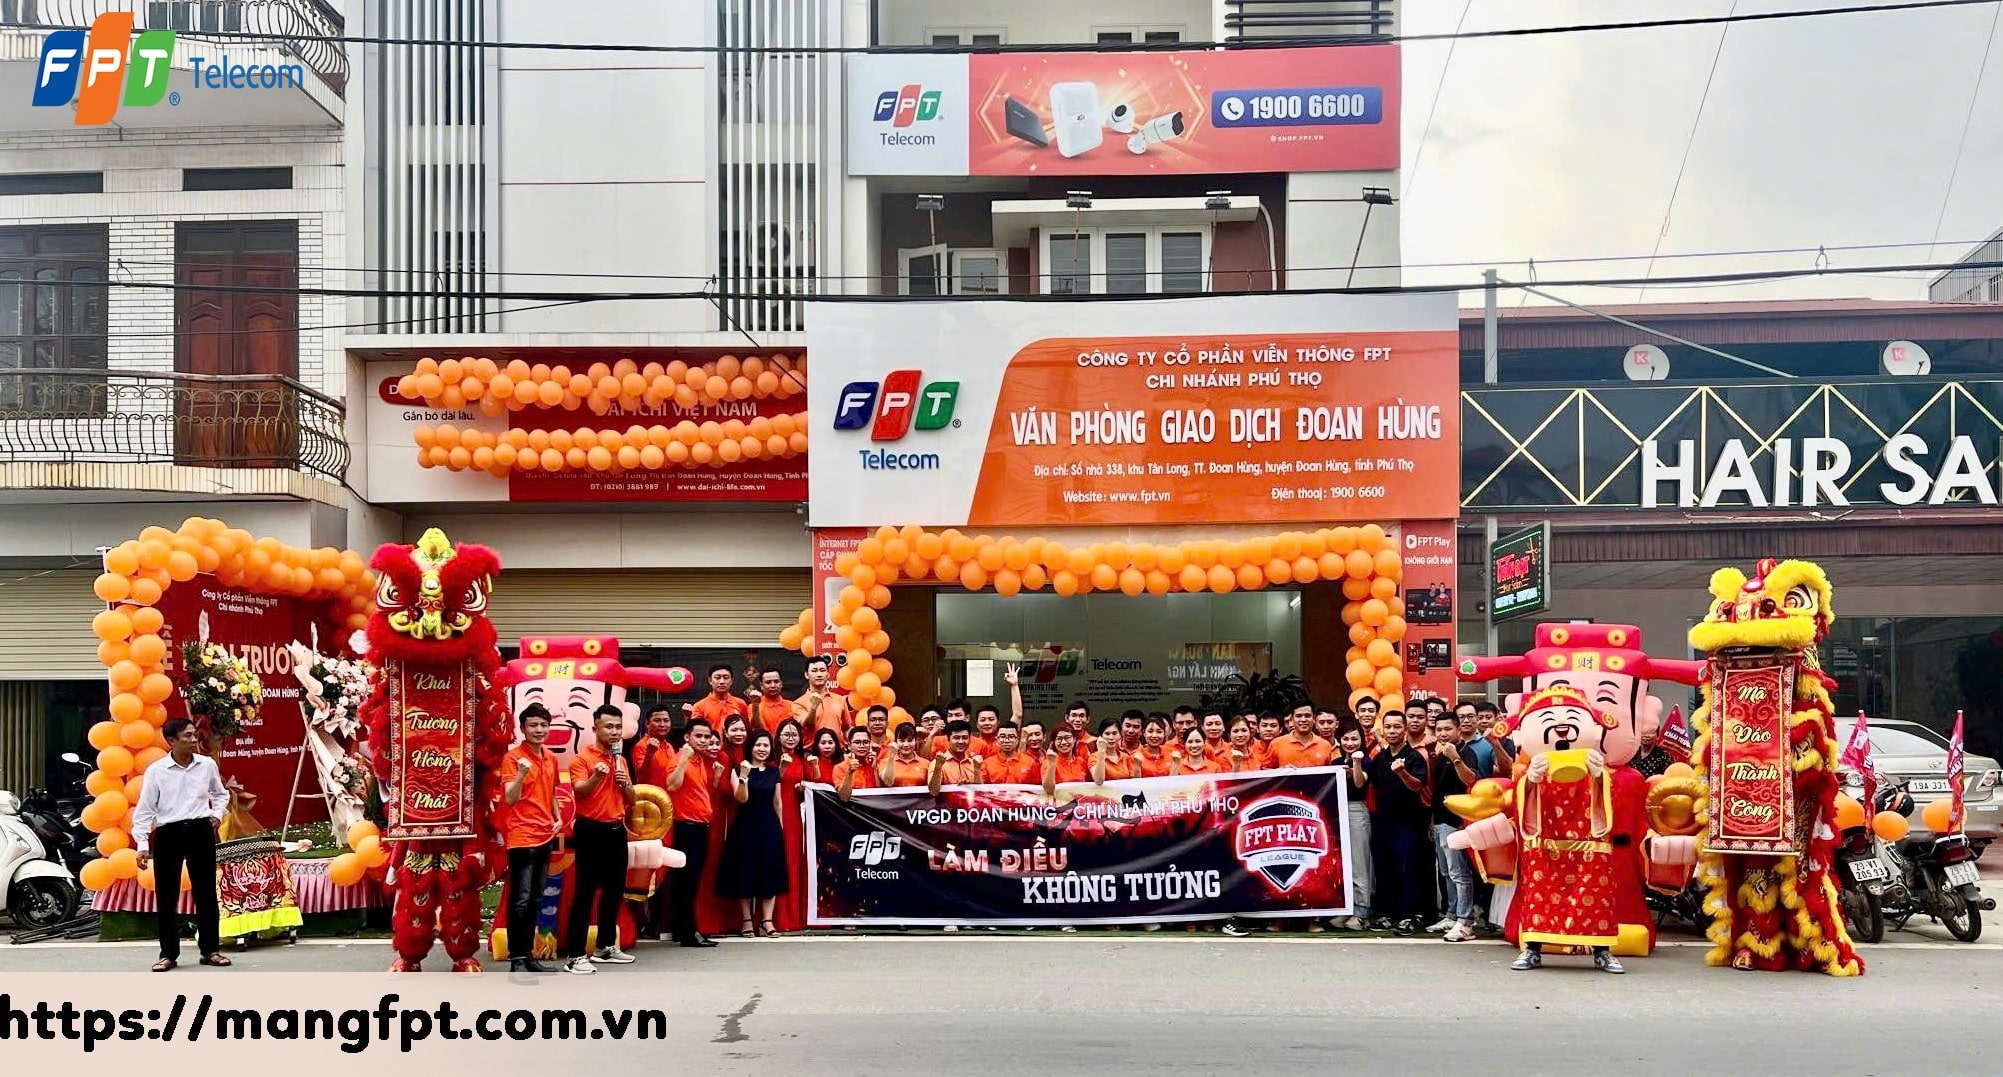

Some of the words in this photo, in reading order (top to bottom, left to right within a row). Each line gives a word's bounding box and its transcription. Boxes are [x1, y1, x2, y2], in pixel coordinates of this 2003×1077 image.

[1249, 95, 1302, 120] 1900
[1308, 93, 1365, 118] 6600
[879, 131, 936, 146] Telecom
[1077, 348, 1129, 367] CÔNG
[1136, 351, 1156, 366] TY
[1163, 342, 1191, 366] CỔ
[1197, 342, 1245, 365] PHẦN
[1251, 342, 1288, 363] VIỄN
[1295, 344, 1355, 363] THÔNG
[1363, 347, 1392, 361] FPT
[1145, 373, 1176, 389] CHI
[1183, 368, 1241, 388] NHÁNH
[1247, 367, 1280, 387] PHÚ
[1288, 371, 1323, 390] THỌ
[716, 402, 757, 416] NAM
[1010, 405, 1057, 446] VĂN
[1070, 402, 1146, 445] PHÒNG
[1160, 408, 1216, 444] GIAO
[1230, 407, 1281, 449] DỊCH
[1295, 406, 1364, 441] ĐOAN
[1377, 397, 1441, 440] HÙNG
[858, 448, 940, 470] Telecom
[1070, 461, 1083, 476] Số
[1085, 464, 1103, 476] nhà
[1106, 464, 1126, 477] 338,
[1128, 463, 1145, 475] khu
[1148, 463, 1164, 475] Tân
[1166, 463, 1191, 477] Long,
[1193, 462, 1207, 474] TT.
[1209, 461, 1234, 473] Đoan
[1236, 461, 1263, 476] Hùng,
[1265, 461, 1293, 476] huyện
[1295, 461, 1322, 473] Đoan
[1325, 460, 1352, 474] Hùng,
[1376, 458, 1395, 471] Phú
[1398, 458, 1414, 473] Thọ
[1641, 437, 1852, 508] HAIR
[1880, 433, 2003, 505] SA
[1063, 490, 1107, 503] Website:
[1109, 489, 1171, 504] www.fpt.vn
[1271, 487, 1295, 501] Điện
[1330, 486, 1355, 498] 1900
[1357, 486, 1385, 498] 6600
[819, 539, 849, 548] INTERNET
[1417, 536, 1434, 546] FPT
[1434, 536, 1451, 548] Play
[1090, 658, 1142, 671] Telecom
[413, 672, 453, 691] Khai
[281, 686, 300, 698] HÙNG
[1737, 685, 1768, 704] Mã
[1732, 724, 1772, 744] Đáo
[411, 750, 453, 774] Hồng
[1726, 763, 1781, 781] Thành
[411, 790, 450, 810] Phát
[1730, 796, 1775, 823] Công
[905, 809, 952, 825] VPGD
[956, 807, 1003, 823] ĐOAN
[1008, 801, 1057, 822] HÙNG
[1073, 803, 1102, 820] CHI
[1106, 798, 1165, 819] NHÁNH
[1169, 796, 1204, 815] PHÚ
[1207, 796, 1239, 814] THỌ
[1243, 824, 1274, 848] FPT
[1276, 823, 1318, 844] PLAY
[928, 843, 989, 873] LÀM
[1000, 836, 1068, 873] ĐIỀU
[1260, 853, 1305, 863] LEAGUE
[854, 867, 899, 880] Telecom
[1021, 870, 1117, 904] KHÔNG
[1123, 864, 1222, 901] TƯỞNG
